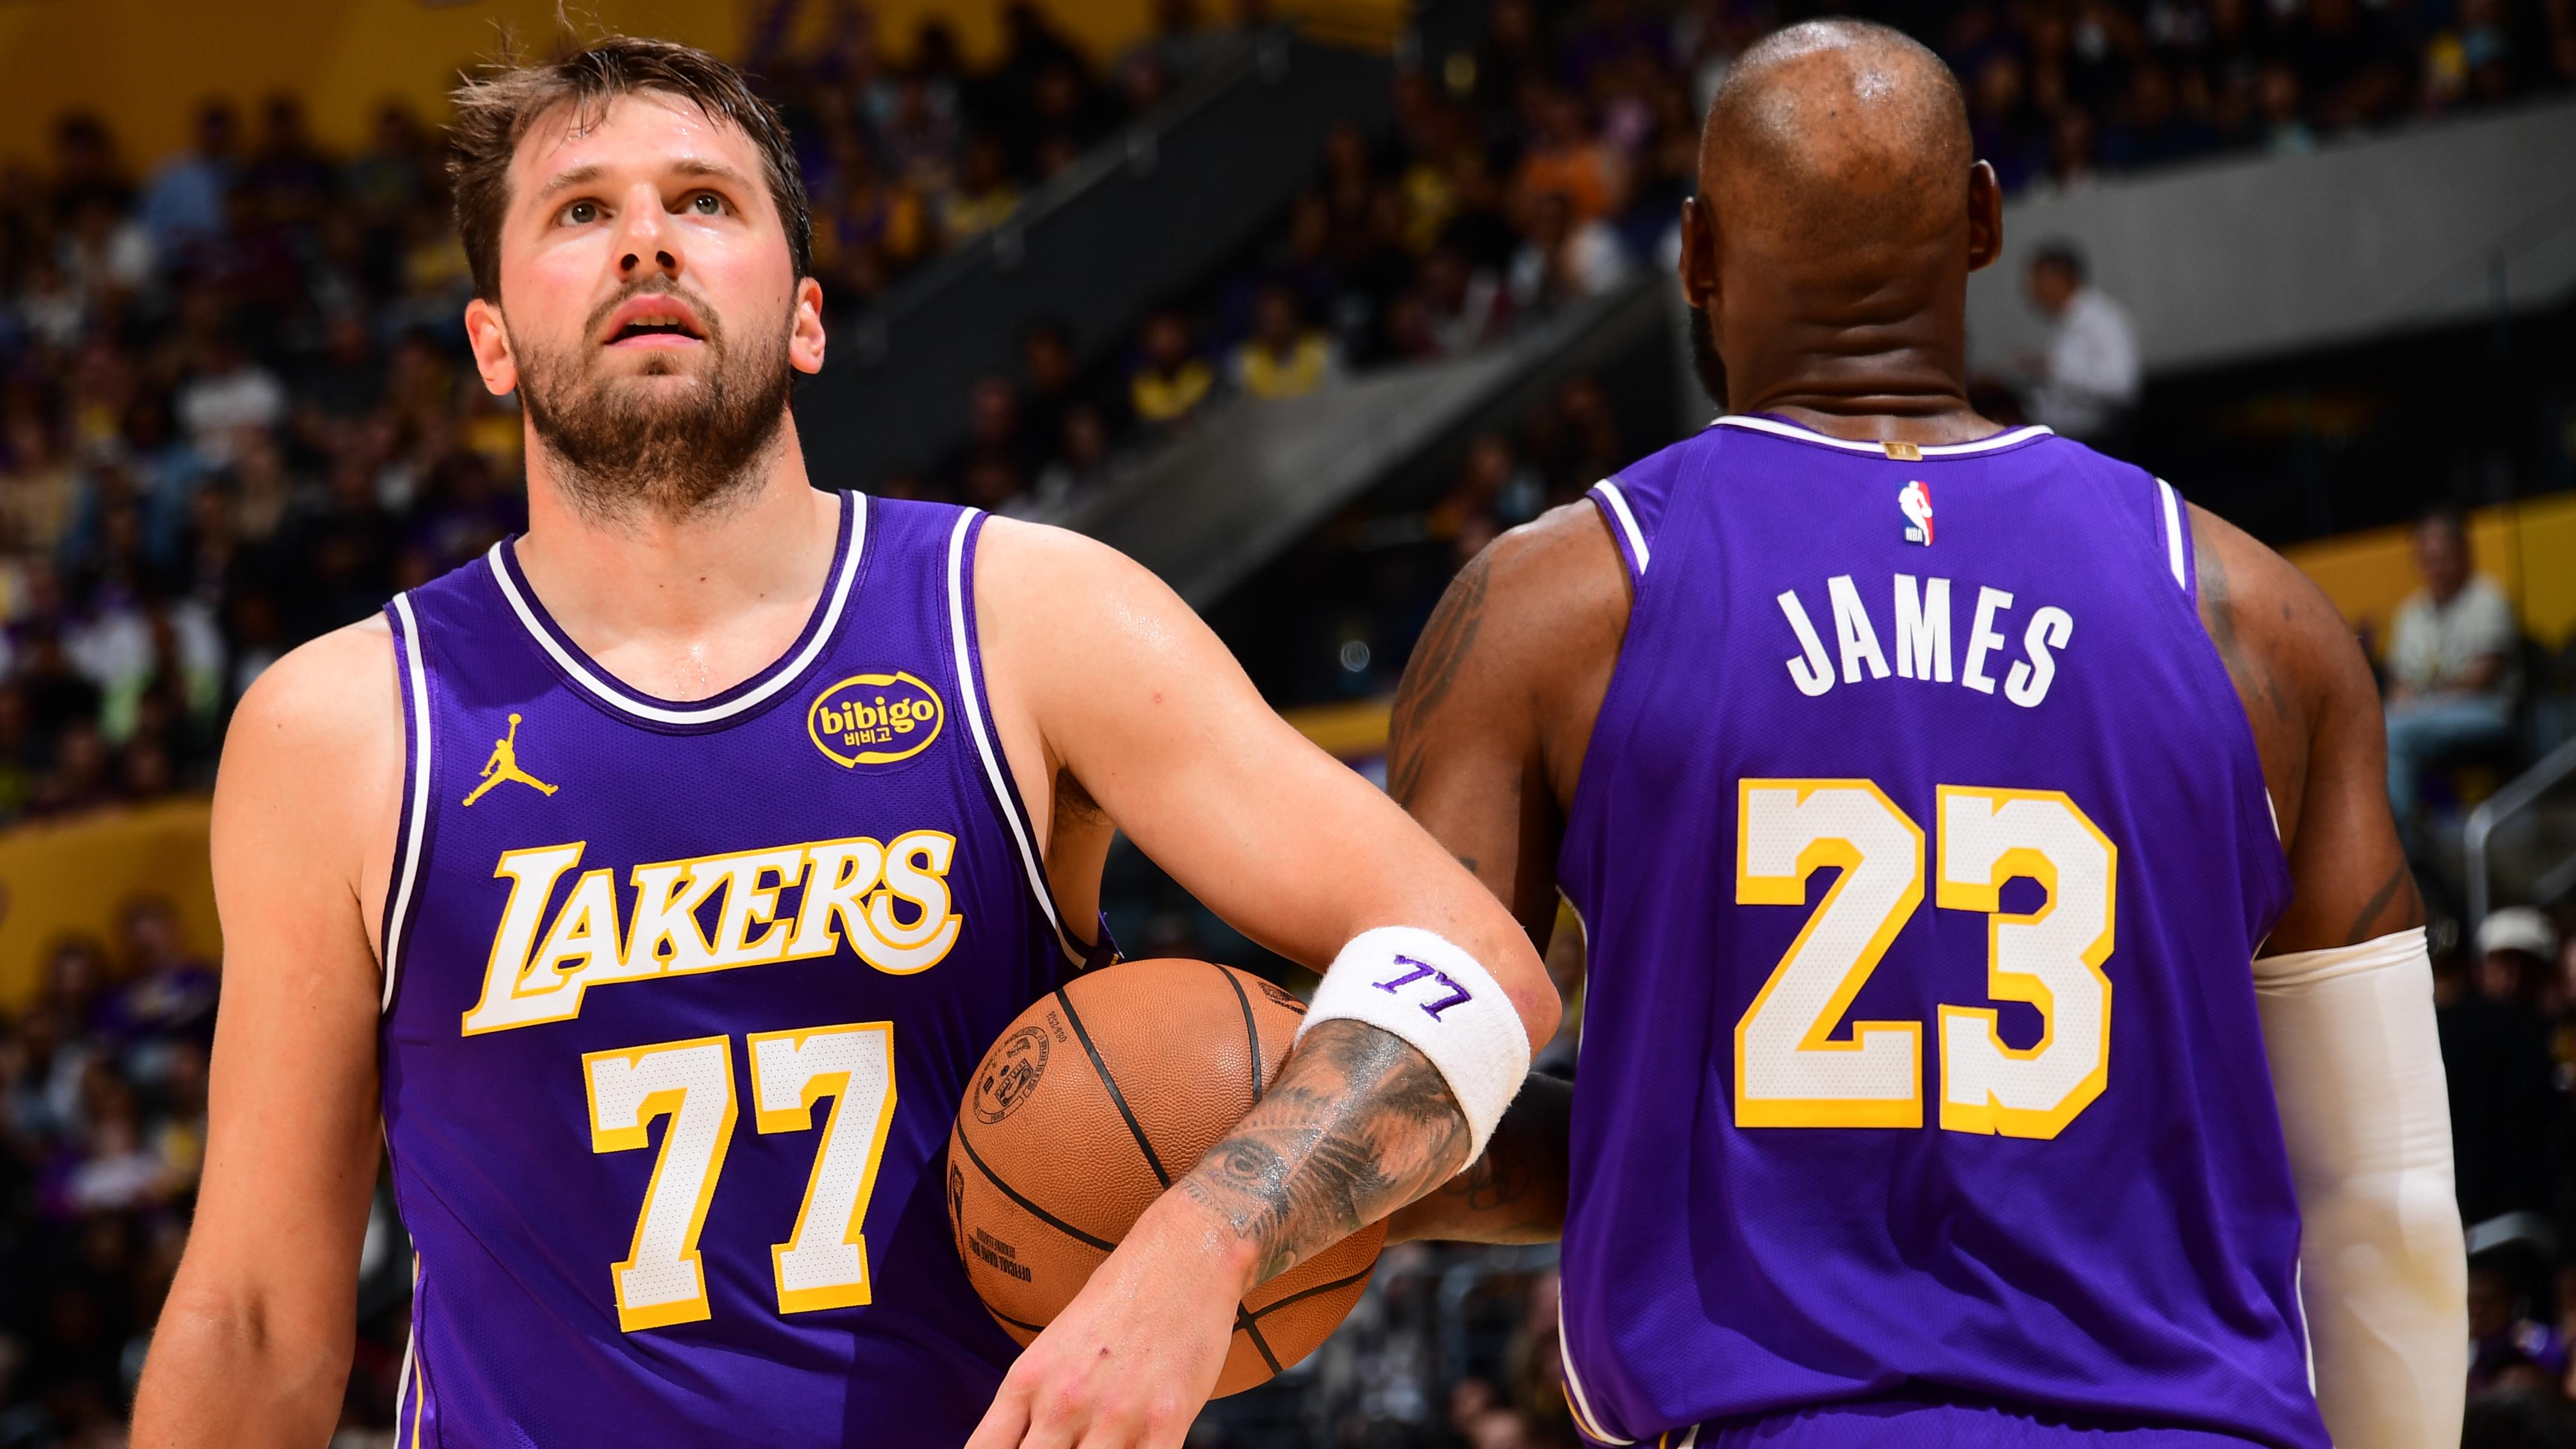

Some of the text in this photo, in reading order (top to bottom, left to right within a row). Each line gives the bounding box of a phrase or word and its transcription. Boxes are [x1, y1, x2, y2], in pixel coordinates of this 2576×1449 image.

[1905, 526, 1923, 542] NBA
[1777, 573, 2073, 708] JAMES
[819, 696, 935, 735] bibigo
[844, 727, 893, 747] 비비고
[461, 829, 962, 1037] LAKERS
[1734, 778, 2118, 1140] 23
[1372, 954, 1473, 1023] 77
[581, 1021, 898, 1333] 77
[999, 1255, 1031, 1283] OFFICIAL
